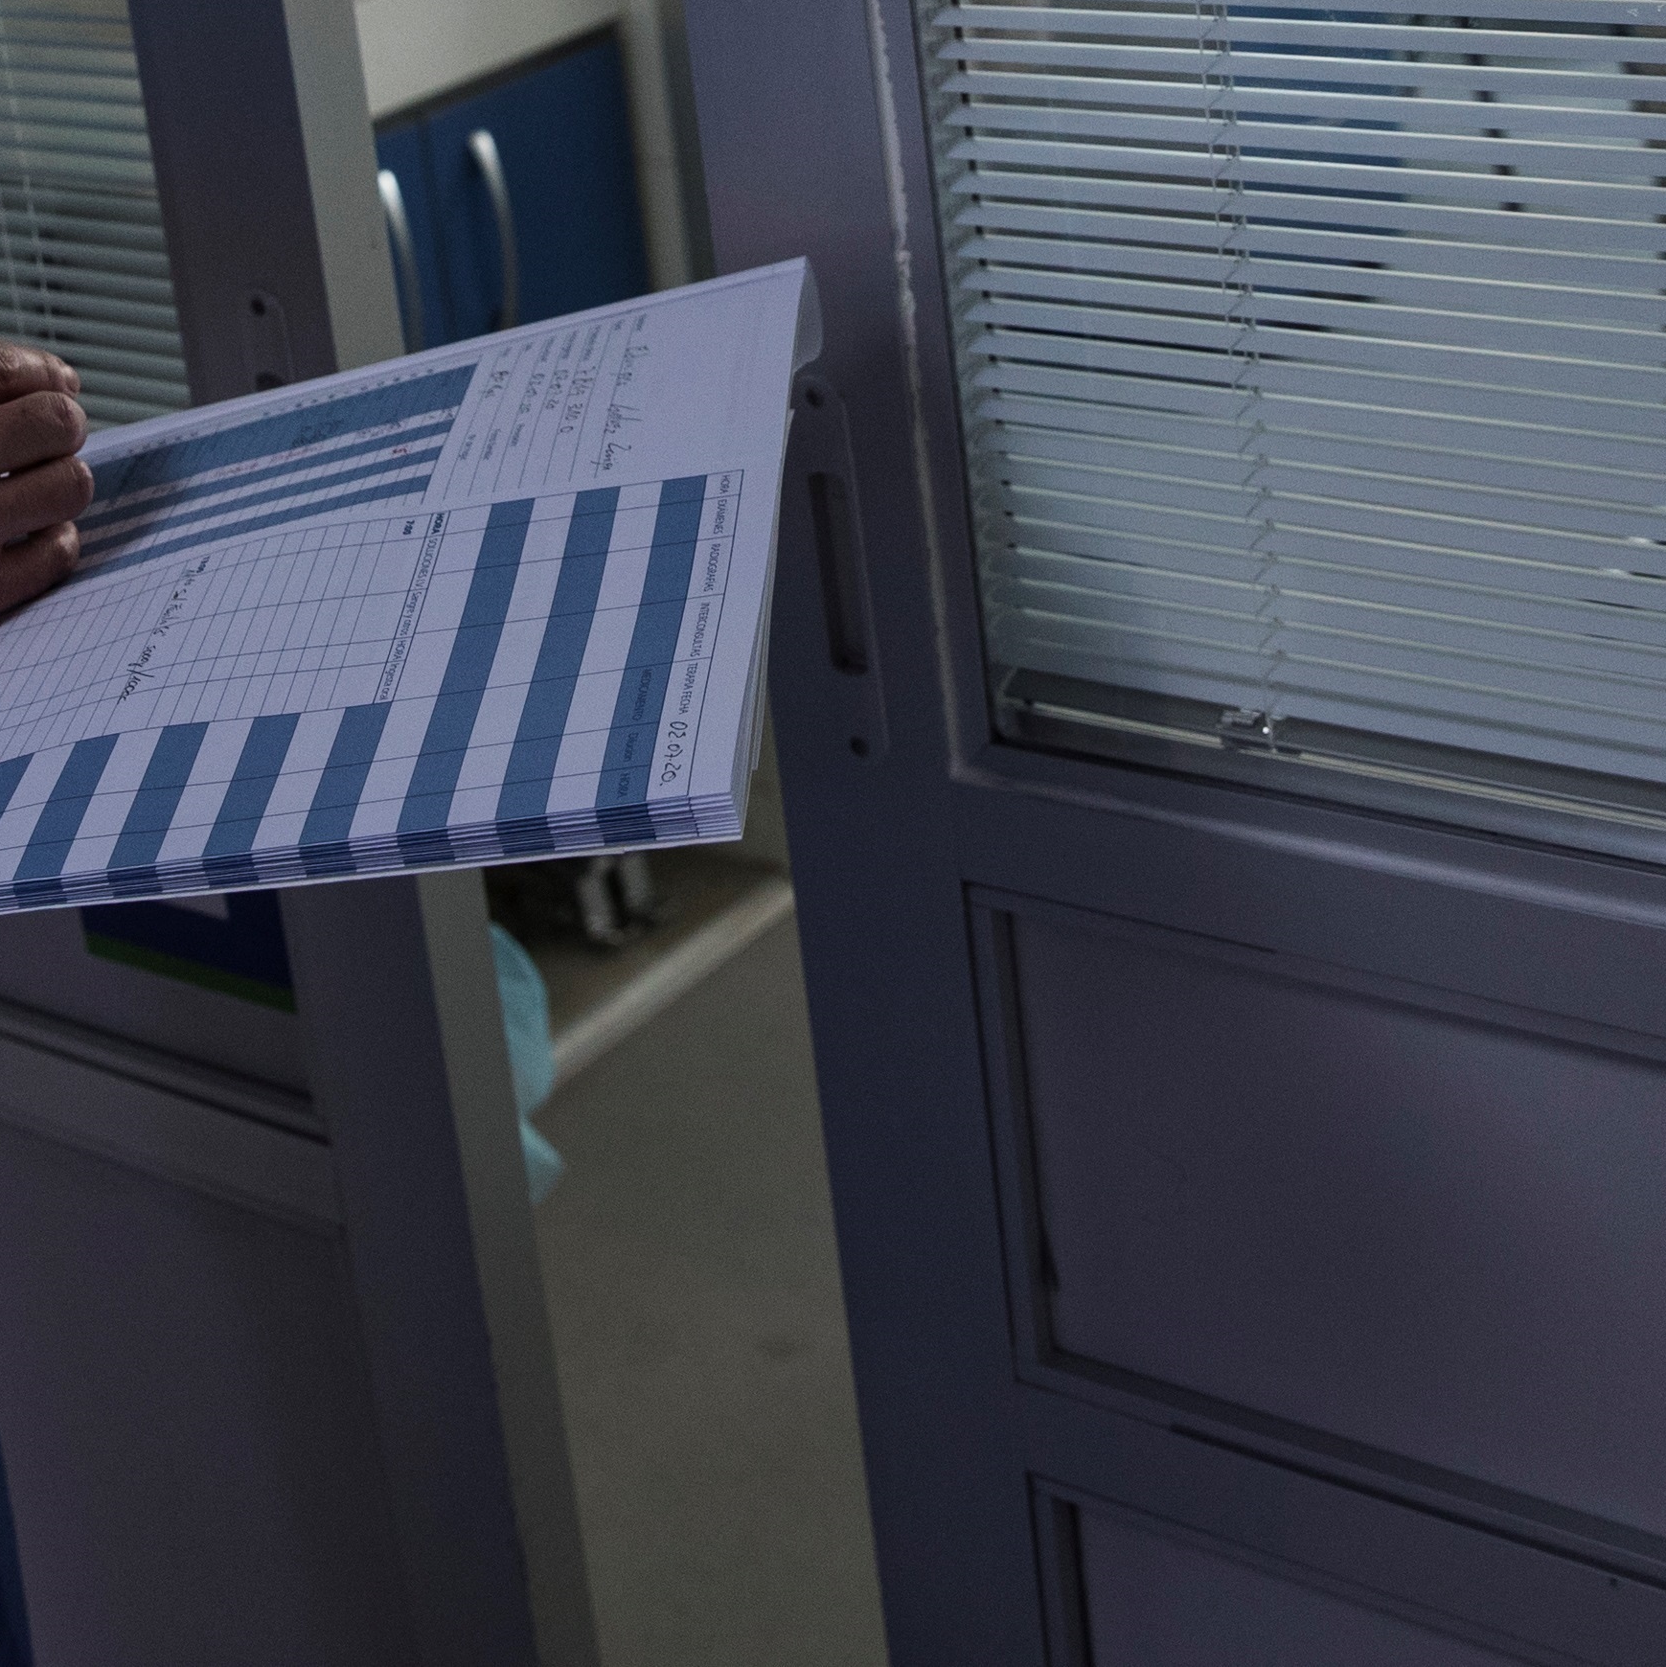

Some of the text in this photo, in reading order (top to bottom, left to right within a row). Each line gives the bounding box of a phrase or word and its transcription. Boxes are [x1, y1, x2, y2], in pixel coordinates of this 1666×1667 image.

[720, 474, 732, 495] HORA
[403, 520, 415, 535] 7:00
[432, 513, 443, 534] HORA
[419, 537, 437, 577] SOLUCIONES
[406, 589, 422, 613] Sangre
[690, 601, 710, 659] INTERCONSULTAS
[394, 640, 406, 661] HORA
[384, 659, 400, 684] Ingesta
[632, 669, 652, 722] MEDICAMENTO
[678, 662, 699, 714] TERAPIA FECHA
[616, 771, 630, 799] HORA
